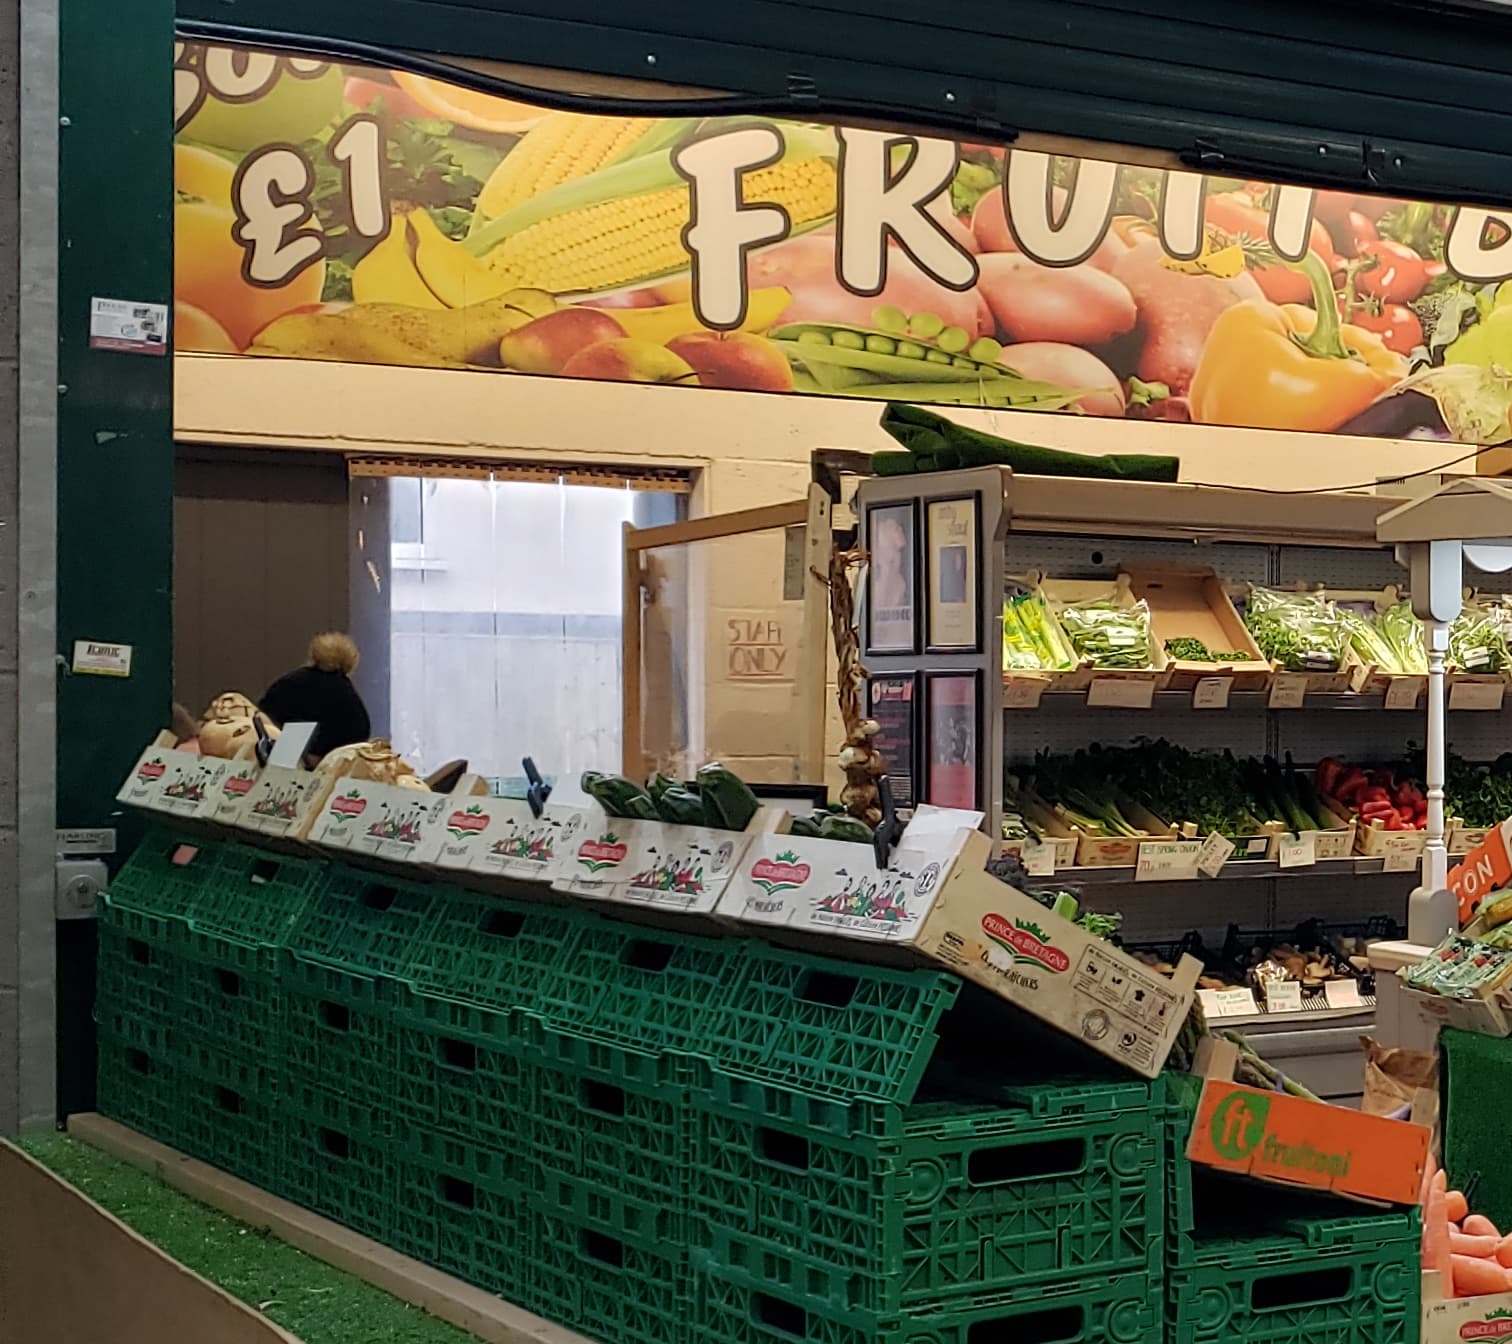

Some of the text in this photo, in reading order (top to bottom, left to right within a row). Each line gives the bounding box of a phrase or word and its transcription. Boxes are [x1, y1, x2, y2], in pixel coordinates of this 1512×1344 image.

[231, 112, 392, 289] £1
[727, 646, 789, 674] ONLY
[983, 915, 1015, 941] PRINCE
[1022, 938, 1069, 971] BRETAGNE
[1461, 1324, 1490, 1338] PRINCE
